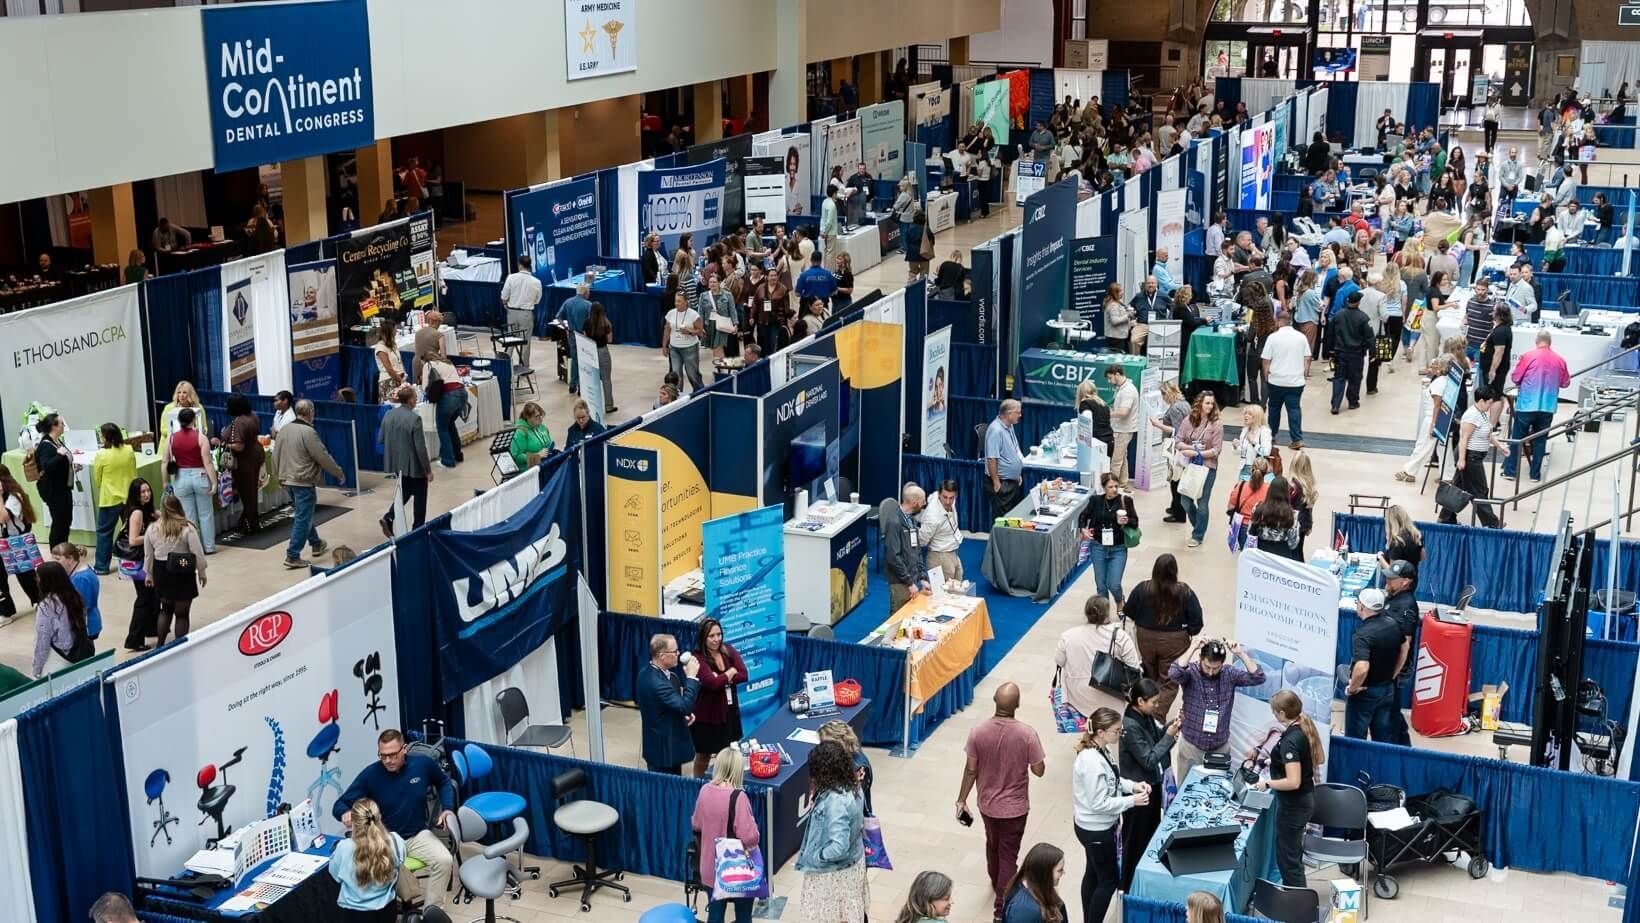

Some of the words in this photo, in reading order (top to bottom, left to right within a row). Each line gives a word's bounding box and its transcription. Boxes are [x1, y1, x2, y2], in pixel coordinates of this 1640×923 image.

[581, 4, 596, 12] ARMY
[597, 2, 621, 11] MEDICINE
[221, 37, 284, 78] Mid-
[222, 67, 362, 134] Continent
[225, 121, 281, 144] DENTAL
[295, 108, 364, 133] CONGRESS
[674, 171, 714, 181] MORTENSON
[1034, 204, 1046, 221] CBIZ
[573, 226, 597, 241] EXPERIENCE
[342, 250, 366, 264] Central
[367, 240, 399, 257] Recycling
[22, 324, 126, 366] THOUSAND.CPA
[1051, 364, 1096, 382] CBIZ
[776, 398, 796, 424] NDX
[616, 458, 636, 469] NDX
[670, 505, 702, 529] TECHNOLOGIES
[664, 532, 688, 551] SOLUTIONS
[673, 546, 692, 562] RESULTS
[718, 554, 736, 566] UMB
[738, 547, 768, 560] Practice
[452, 522, 567, 622] UMB
[720, 564, 748, 577] Finance
[720, 574, 752, 587] Solutions
[1262, 572, 1322, 596] ORASCOPTIC
[1244, 590, 1248, 598] 2
[1244, 603, 1294, 626] ERGONOMIC
[248, 614, 284, 650] RGP
[228, 700, 243, 712] Doing
[250, 691, 258, 700] the
[258, 684, 271, 695] right
[271, 679, 282, 690] way,
[282, 672, 295, 682] since
[746, 678, 774, 692] UMB
